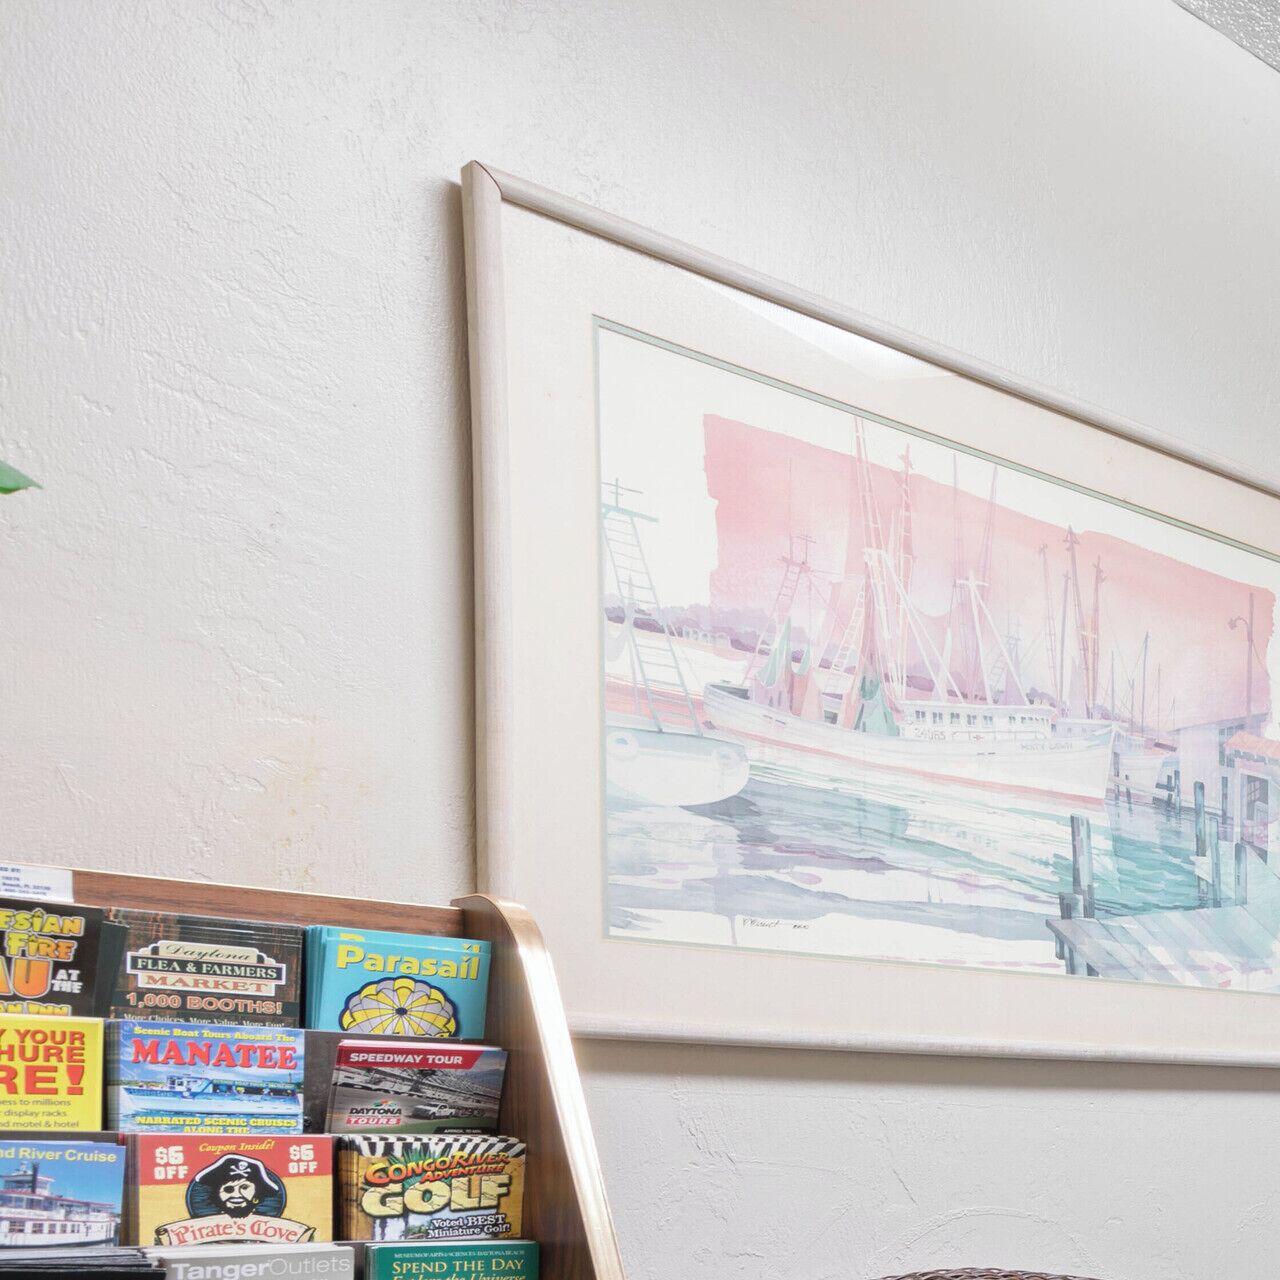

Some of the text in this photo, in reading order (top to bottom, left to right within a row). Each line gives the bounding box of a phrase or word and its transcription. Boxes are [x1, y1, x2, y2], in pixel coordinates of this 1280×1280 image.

[165, 943, 251, 961] Daytona
[336, 944, 481, 980] Parasail
[56, 969, 80, 981] AT
[145, 975, 269, 992] MARKET
[130, 1039, 297, 1069] MANATEE
[350, 1053, 462, 1065] SPEEDWAY TOUR
[136, 1117, 297, 1127] NARRATED SCENIC CRUISES
[18, 1148, 117, 1163] River Cruise
[421, 1164, 505, 1183] ADVENTURE
[361, 1174, 512, 1217] GOLF
[431, 1214, 505, 1229] Voted BEST
[170, 1219, 298, 1244] Pirate's Cove
[427, 1222, 511, 1239] Miniature Golf!
[392, 1258, 525, 1274] SPEND THE DAY
